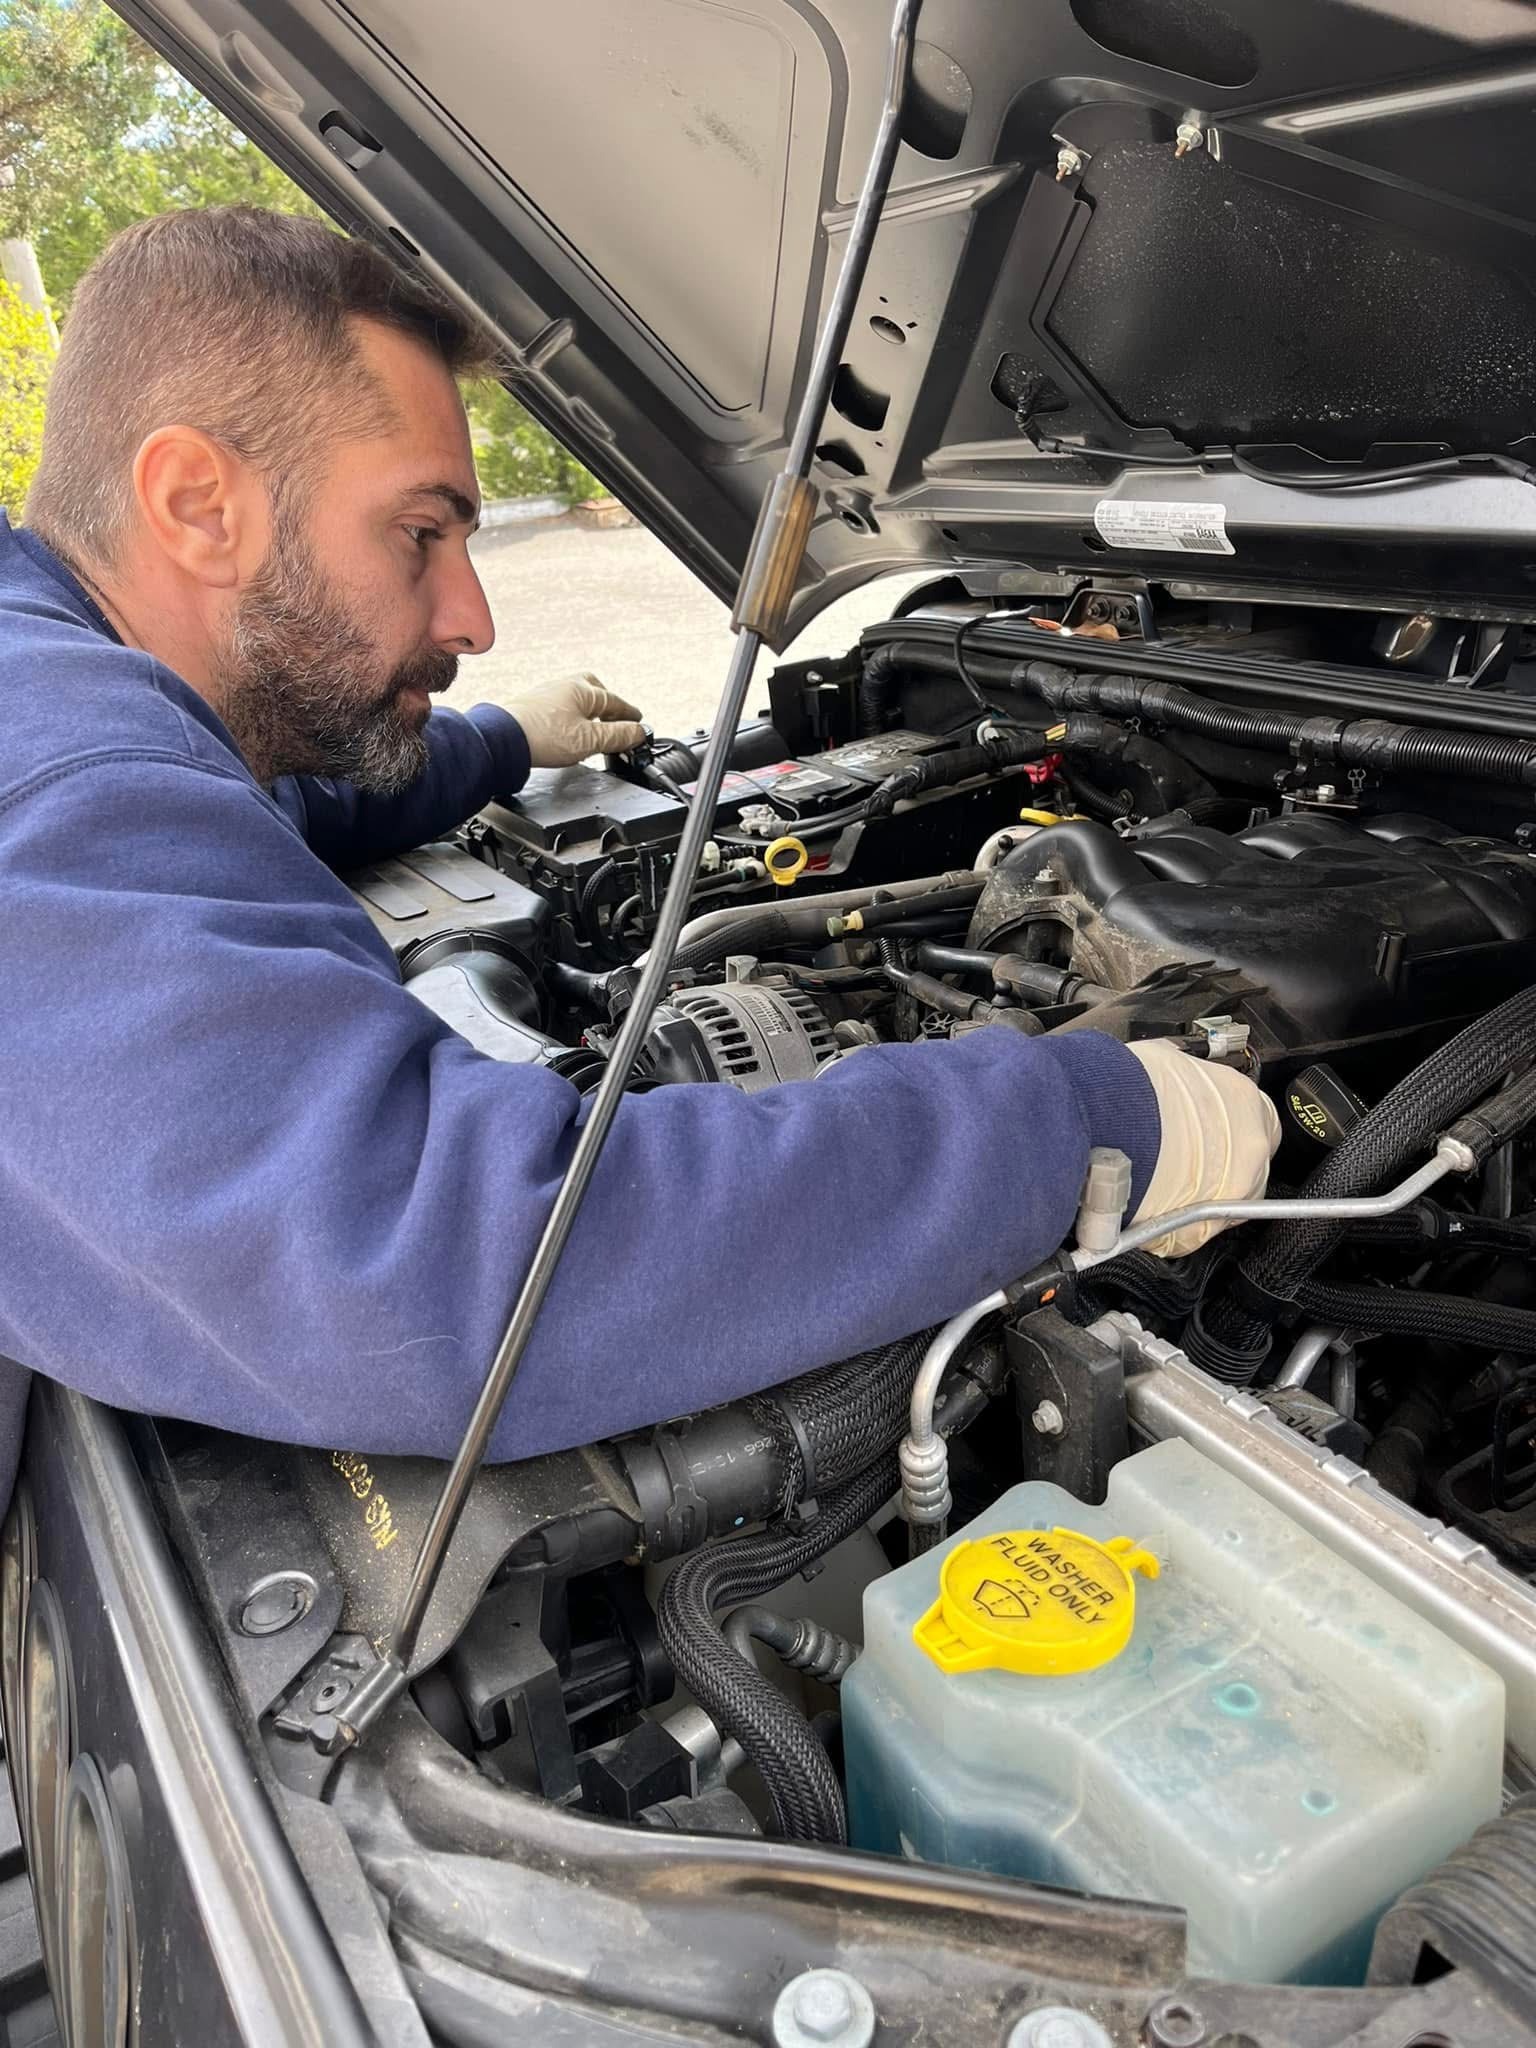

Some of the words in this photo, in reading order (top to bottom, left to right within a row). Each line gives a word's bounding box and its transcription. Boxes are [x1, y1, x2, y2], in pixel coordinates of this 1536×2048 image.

[1291, 1094, 1303, 1112] SAE
[1299, 1112, 1326, 1138] 5W-20
[990, 1536, 1050, 1583] FLUID
[1048, 1583, 1106, 1625] ONLY
[1027, 1537, 1115, 1606] WASHER
